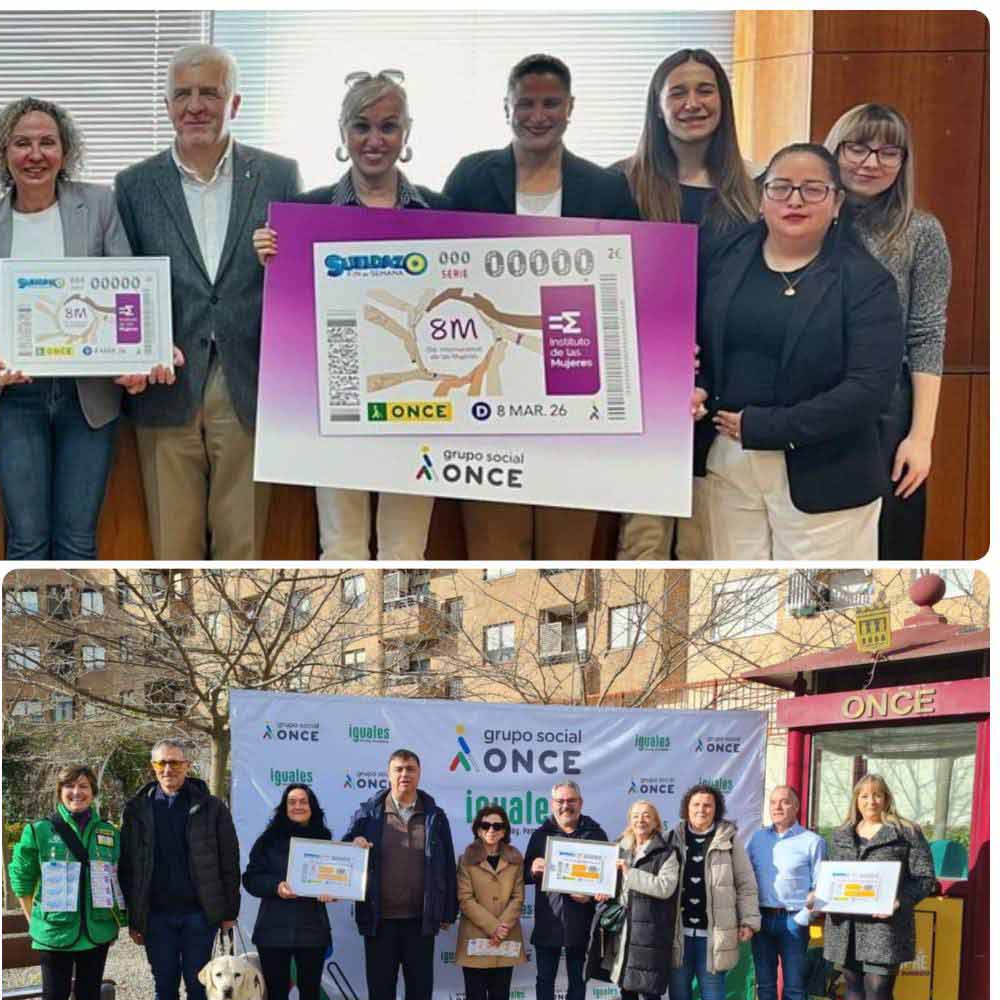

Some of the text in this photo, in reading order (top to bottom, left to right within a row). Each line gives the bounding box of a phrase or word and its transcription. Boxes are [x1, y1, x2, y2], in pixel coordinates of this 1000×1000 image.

[439, 251, 471, 264] 000
[484, 248, 595, 277] 00000
[441, 269, 469, 279] SERIE
[90, 277, 141, 290] 00000
[430, 318, 479, 341] 8M
[549, 338, 591, 347] Instituto
[549, 358, 593, 370] Mujeres
[391, 404, 448, 418] ONCE
[496, 404, 506, 417] 8
[509, 404, 548, 417] MAR.
[549, 404, 568, 417] 26
[443, 449, 525, 465] grupo social
[442, 464, 524, 488] ONCE
[841, 688, 937, 720] ONCE
[276, 729, 320, 742] ONCE
[348, 723, 391, 743] iguales
[484, 729, 582, 744] grupo social
[706, 743, 741, 753] ONCE
[484, 748, 582, 775] ONCE
[270, 768, 313, 786] iguales
[356, 779, 391, 789] ONC
[640, 784, 676, 794] ONCE
